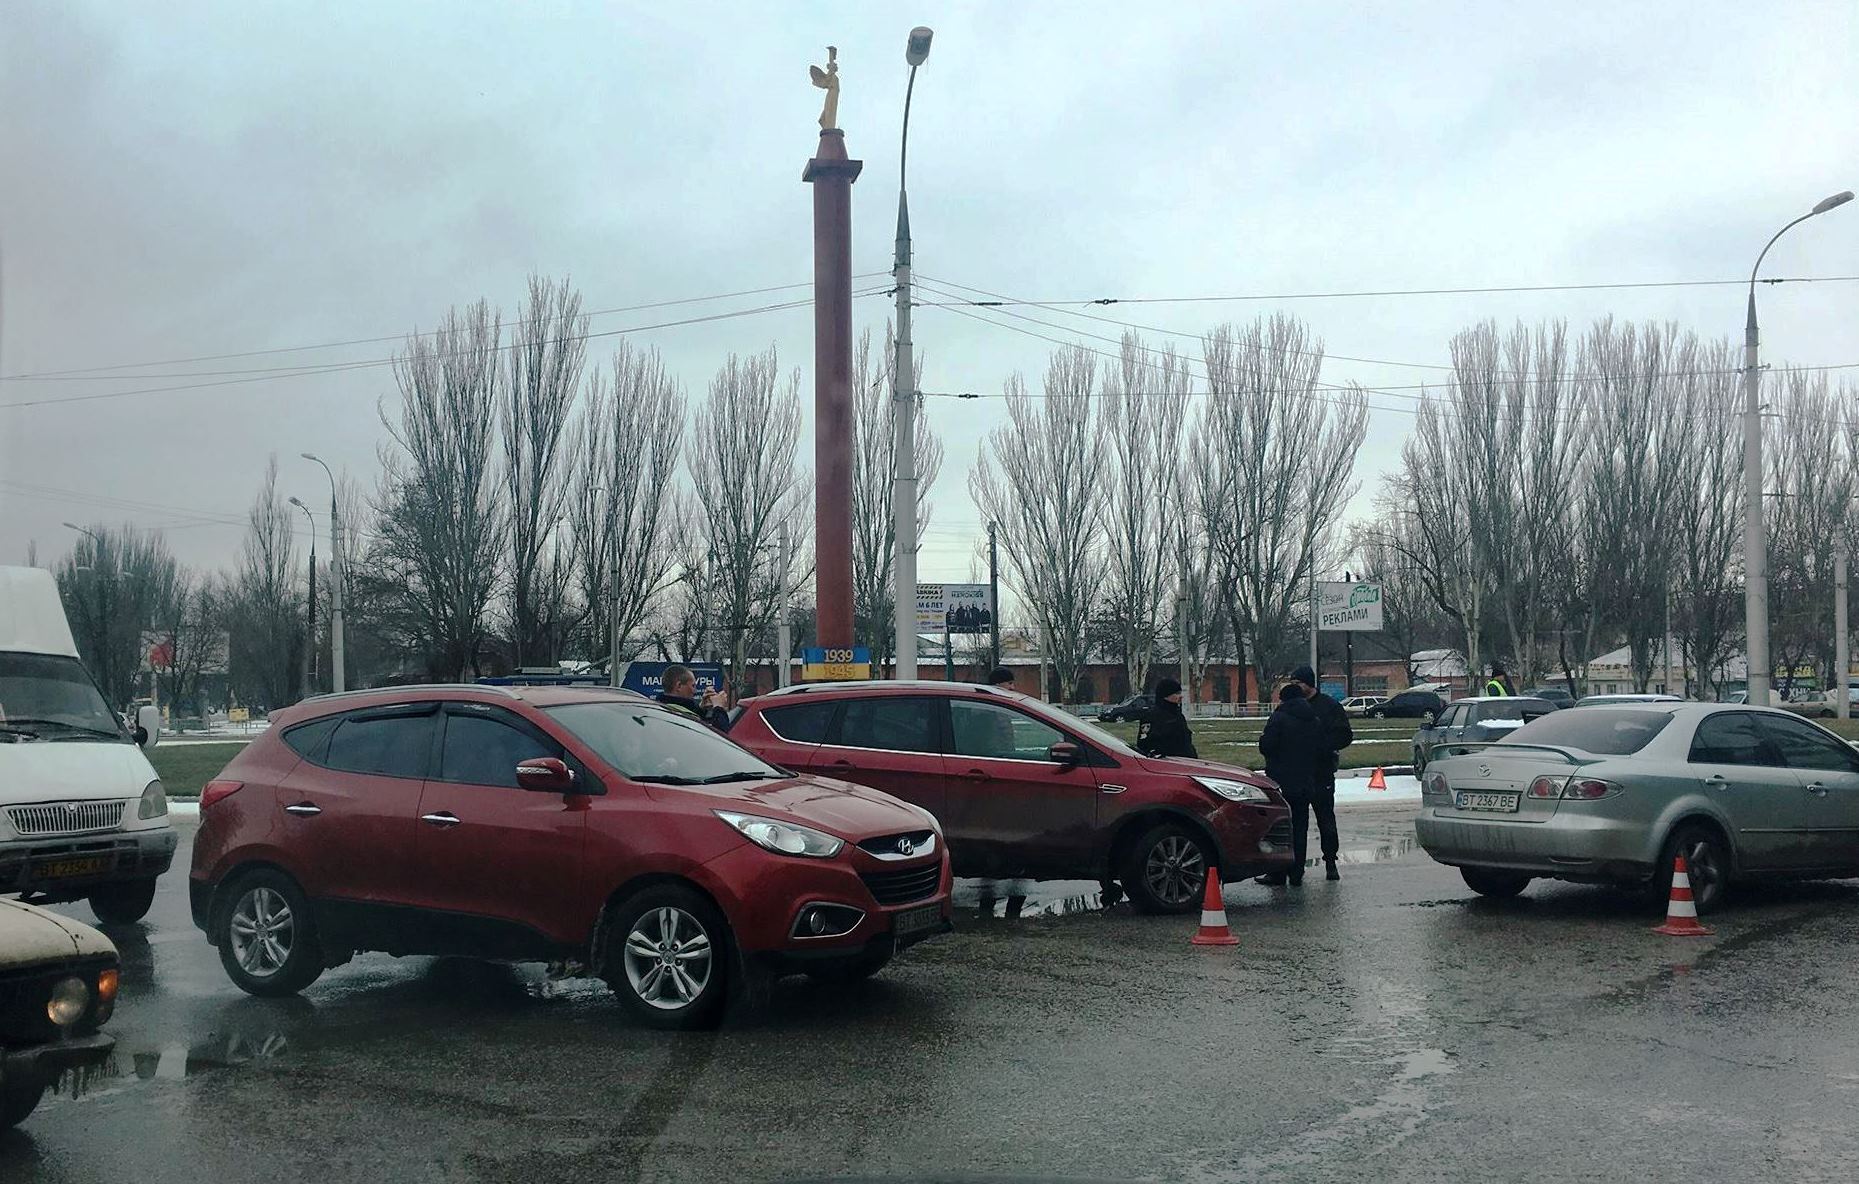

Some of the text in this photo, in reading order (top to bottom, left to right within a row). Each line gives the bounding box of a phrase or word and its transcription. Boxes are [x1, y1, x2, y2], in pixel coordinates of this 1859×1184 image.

[1322, 608, 1369, 627] РЕКЛАМИ
[824, 649, 854, 663] 1939
[824, 663, 856, 679] 1945
[1462, 794, 1516, 808] BT 2367 BE
